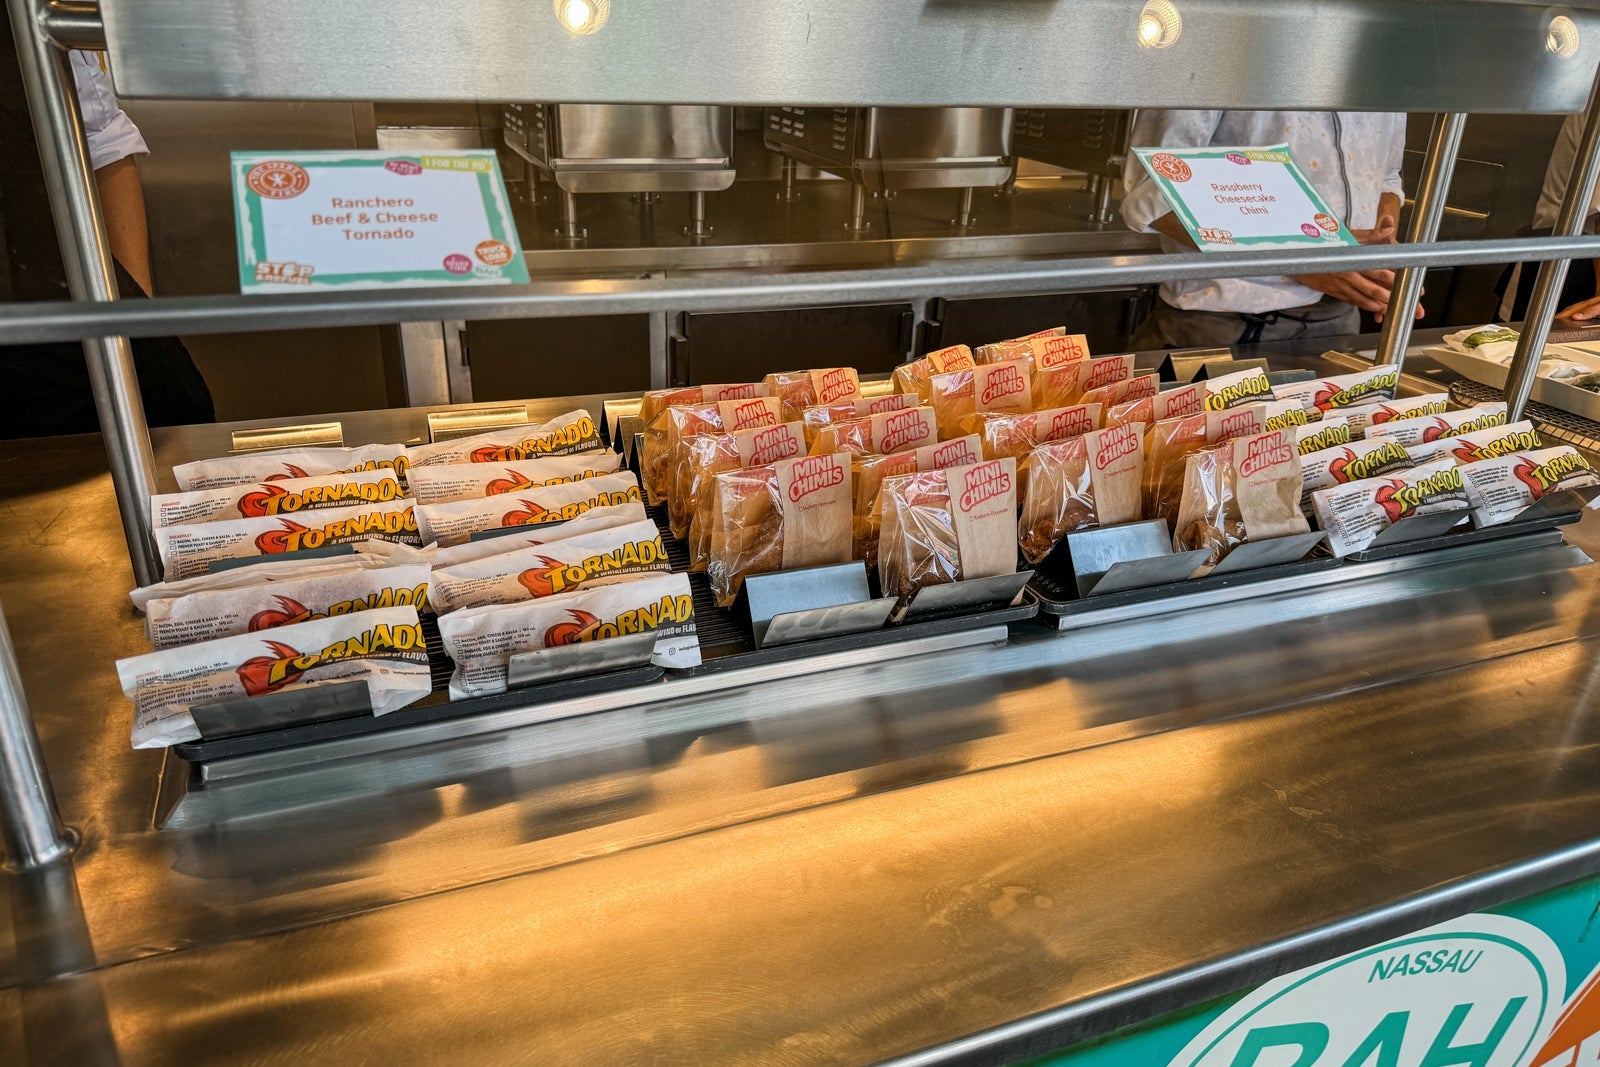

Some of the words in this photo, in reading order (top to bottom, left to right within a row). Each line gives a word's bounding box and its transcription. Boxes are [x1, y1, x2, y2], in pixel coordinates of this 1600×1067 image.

[453, 160, 468, 168] THE
[1211, 183, 1262, 193] Raspberry
[1215, 194, 1276, 204] Cheesecake
[332, 197, 414, 209] Ranchero
[1239, 206, 1270, 215] Chimi
[312, 213, 352, 226] Beef
[358, 213, 370, 224] &
[376, 211, 439, 224] Cheese
[342, 228, 414, 241] Tornado
[941, 347, 962, 365] MINI
[1042, 345, 1084, 367] CHIMIS
[1045, 337, 1073, 354] MINI
[823, 368, 846, 389] MINI
[987, 365, 1016, 386] MINI
[1092, 357, 1123, 377] MINI
[820, 379, 856, 403] CHIMIS
[982, 376, 1025, 405] CHIMIS
[1083, 367, 1128, 392] CHIMIS
[1126, 376, 1152, 397] MINI
[1329, 371, 1397, 408] TORNADO
[870, 395, 909, 415] MINI
[1167, 388, 1195, 412] MINI
[1205, 374, 1270, 412] TORNADO
[736, 400, 766, 425] MINI
[886, 409, 919, 434] MINI
[1053, 408, 1086, 431] MINI
[1222, 411, 1253, 435] MINI
[493, 417, 594, 462] TORNADO
[575, 440, 598, 451] FLAVOR!
[754, 425, 788, 449] MINI
[881, 421, 930, 454] CHIMIS
[1099, 423, 1130, 449] MINI
[1248, 432, 1281, 459] MINI
[749, 437, 799, 466] CHIMIS
[934, 439, 967, 469] MINI
[1096, 433, 1138, 470] CHIMIS
[1240, 444, 1293, 478] CHIMIS
[793, 455, 834, 482] MINI
[965, 460, 1001, 491] MINI
[788, 466, 844, 502] CHIMIS
[960, 473, 1011, 513] CHIMIS
[1391, 466, 1463, 514] TORNADO
[263, 477, 397, 516] TORNADO
[315, 500, 359, 508] WHIRLWIND
[281, 506, 418, 553] TORNADO
[339, 534, 383, 544] WHIRLWIND
[392, 535, 420, 544] FLAVOR!
[600, 566, 641, 577] WHIRLWIND
[1367, 949, 1484, 984] NASSAU
